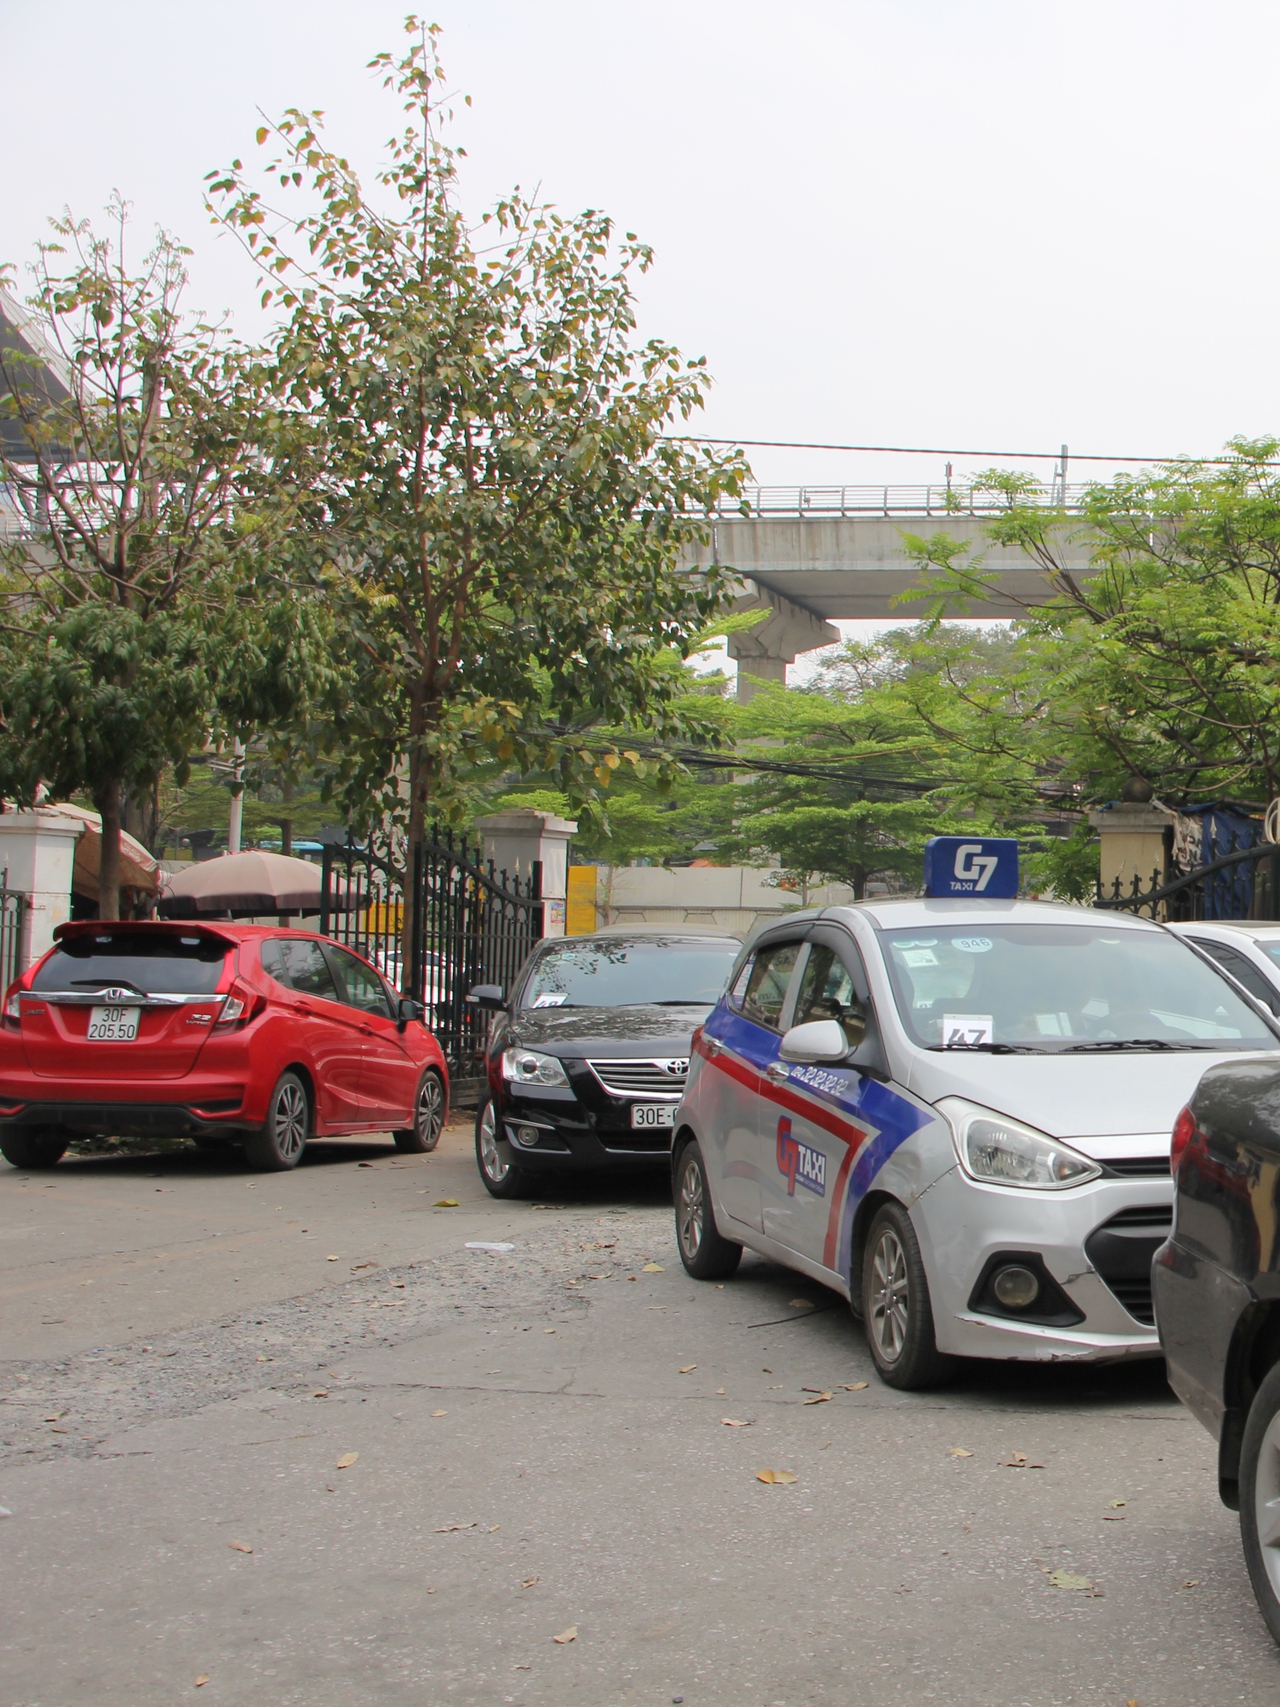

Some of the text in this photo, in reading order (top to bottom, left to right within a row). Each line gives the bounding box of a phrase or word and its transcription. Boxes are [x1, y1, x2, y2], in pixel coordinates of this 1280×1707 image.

[954, 844, 998, 891] G7
[950, 881, 973, 890] TAXI
[961, 938, 990, 949] 946
[102, 1008, 129, 1022] 30F
[89, 1024, 136, 1039] 205.50
[948, 1029, 987, 1046] 47
[798, 1144, 826, 1185] TAXI
